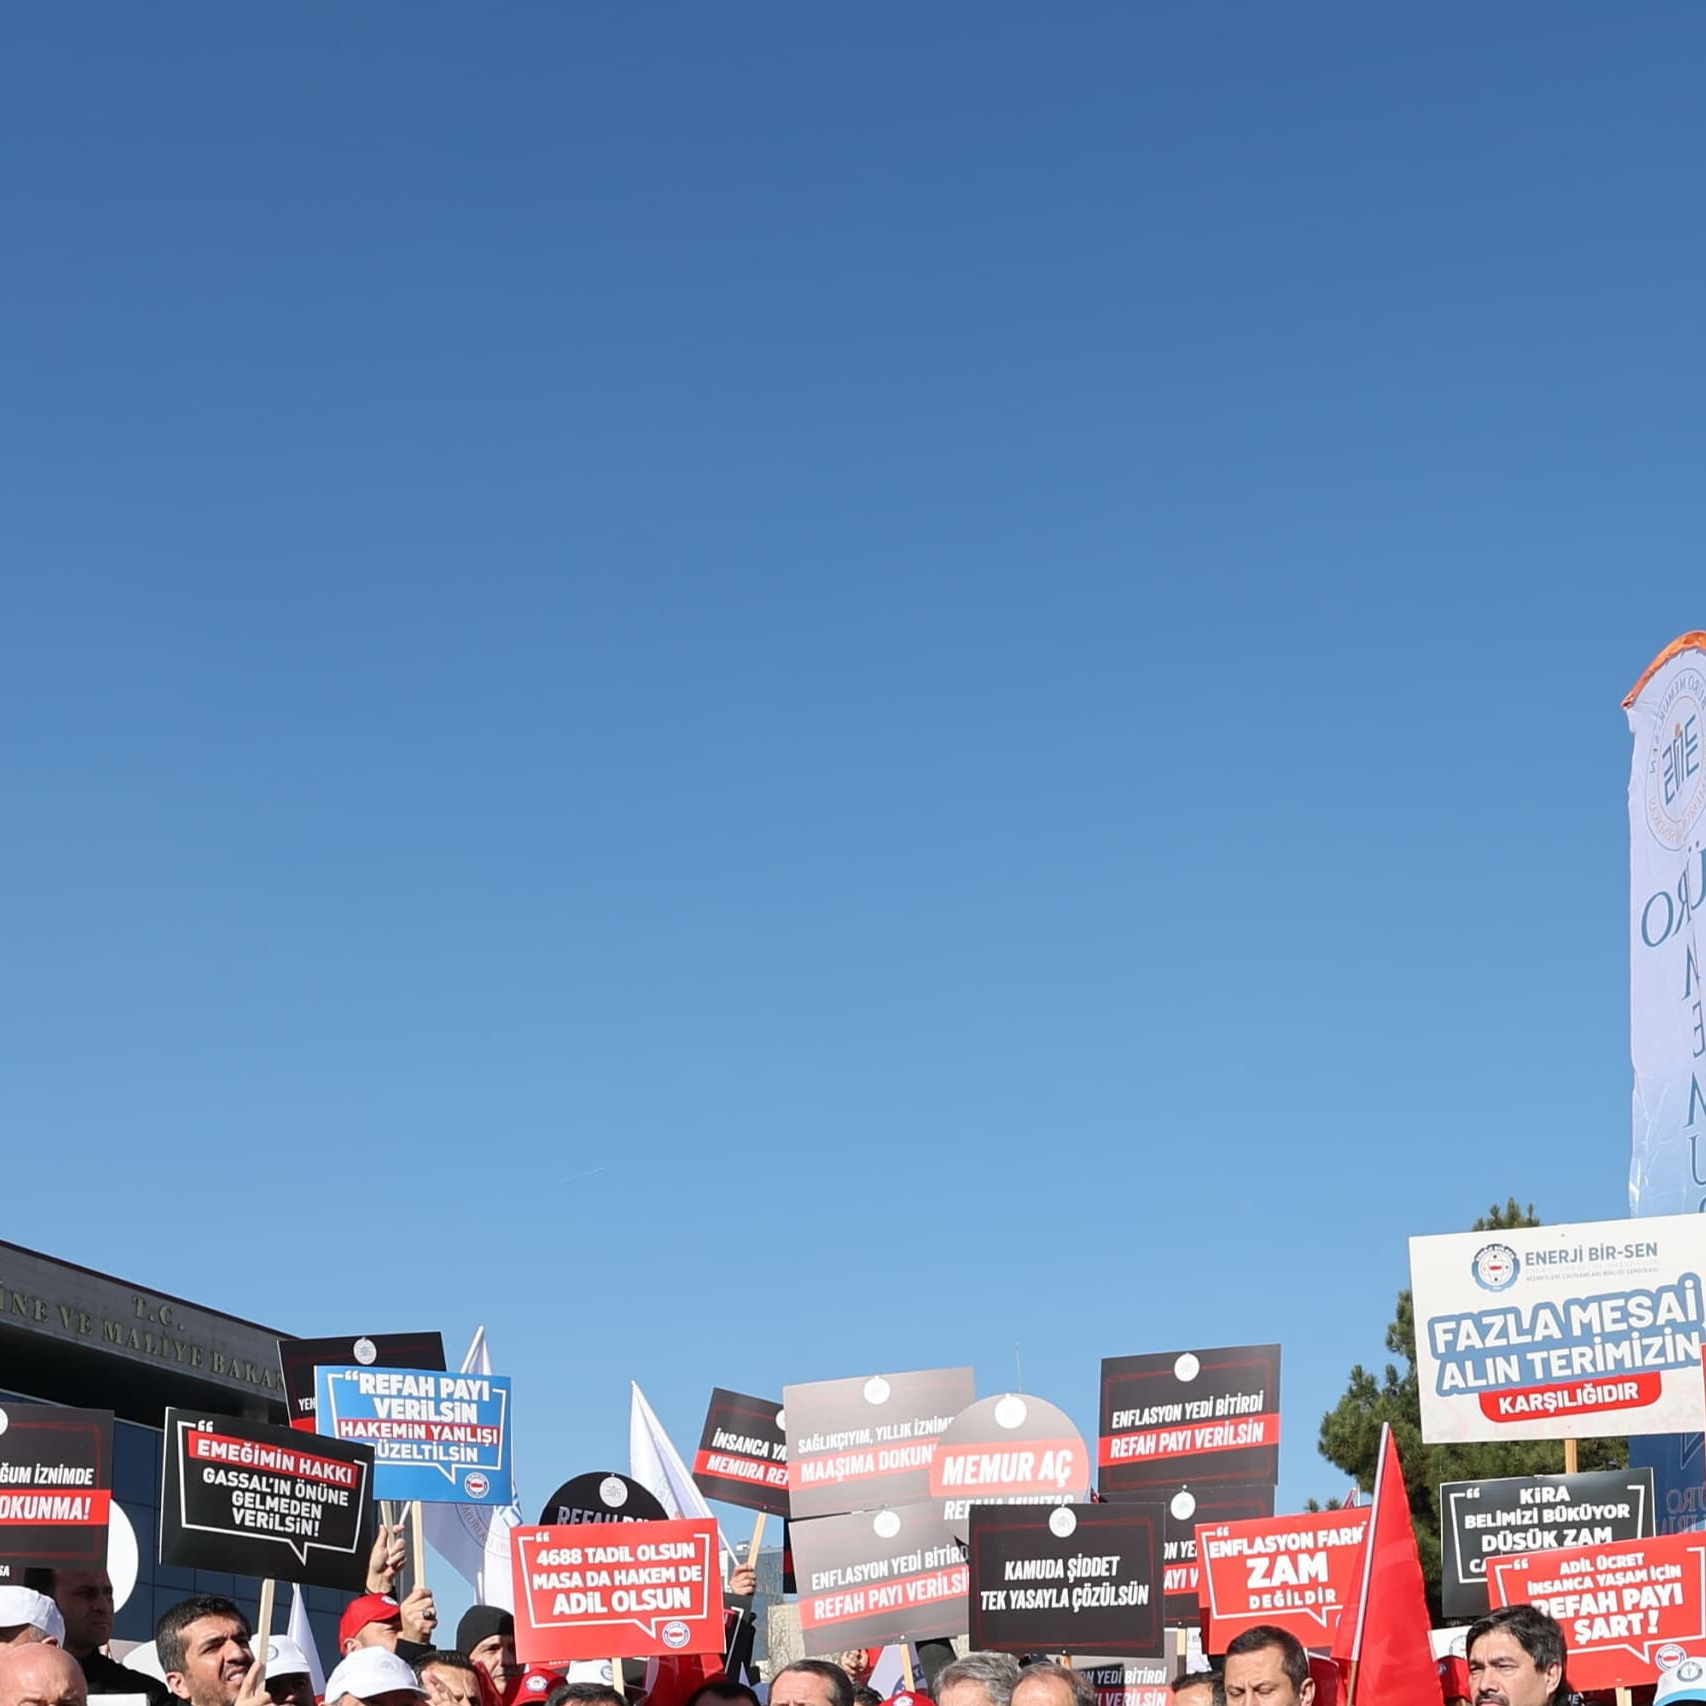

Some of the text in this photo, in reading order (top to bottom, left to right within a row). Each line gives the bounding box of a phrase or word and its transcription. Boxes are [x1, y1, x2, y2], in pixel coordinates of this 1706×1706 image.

[1525, 1245, 1583, 1267] ENERJİ
[1589, 1242, 1658, 1262] BİR-SEN
[132, 1296, 185, 1331] T.C.
[1433, 1279, 1698, 1354] FAZLA MESAİ
[59, 1305, 92, 1337] VE
[103, 1320, 204, 1367] MALİYE
[1442, 1327, 1701, 1391] ALIN TERİMİZİN
[359, 1374, 490, 1401] REFAH PAYI
[1499, 1382, 1639, 1416] KARŞILIĞIDIR
[373, 1397, 478, 1424] VERİLSİN
[1112, 1390, 1264, 1429] ENFLASYON YEDİ BİTİRDİ
[340, 1421, 498, 1446] HAKEMİN YANLIŞI
[1111, 1418, 1264, 1459] REFAH PAYI VERİLSİN
[34, 1463, 93, 1486] İZNİMDE
[197, 1438, 353, 1483] EMEĞİMİN HAKKI
[943, 1449, 1072, 1489] MEMUR AÇ
[232, 1490, 322, 1520] GELMEDEN
[295, 1482, 349, 1506] ÖNÜNE
[1520, 1485, 1571, 1504] KİRA
[233, 1506, 320, 1537] VERİLSİN!
[1465, 1504, 1630, 1530] BELİMİZİ BÜKÜYOR
[537, 1542, 695, 1566] 4688 TADİL OLSUN
[1209, 1530, 1314, 1559] ENFLASYON
[534, 1566, 702, 1590] MASA DA HAKEM DE
[1005, 1553, 1120, 1582] KAMUDA ŞİDDET
[1246, 1553, 1329, 1589] ZAM
[553, 1588, 691, 1616] ADİL OLSUN
[980, 1584, 1149, 1612] TEK YASAYLA ÇÖZÜLSÜN
[1249, 1587, 1335, 1610] DEĞİLDİR
